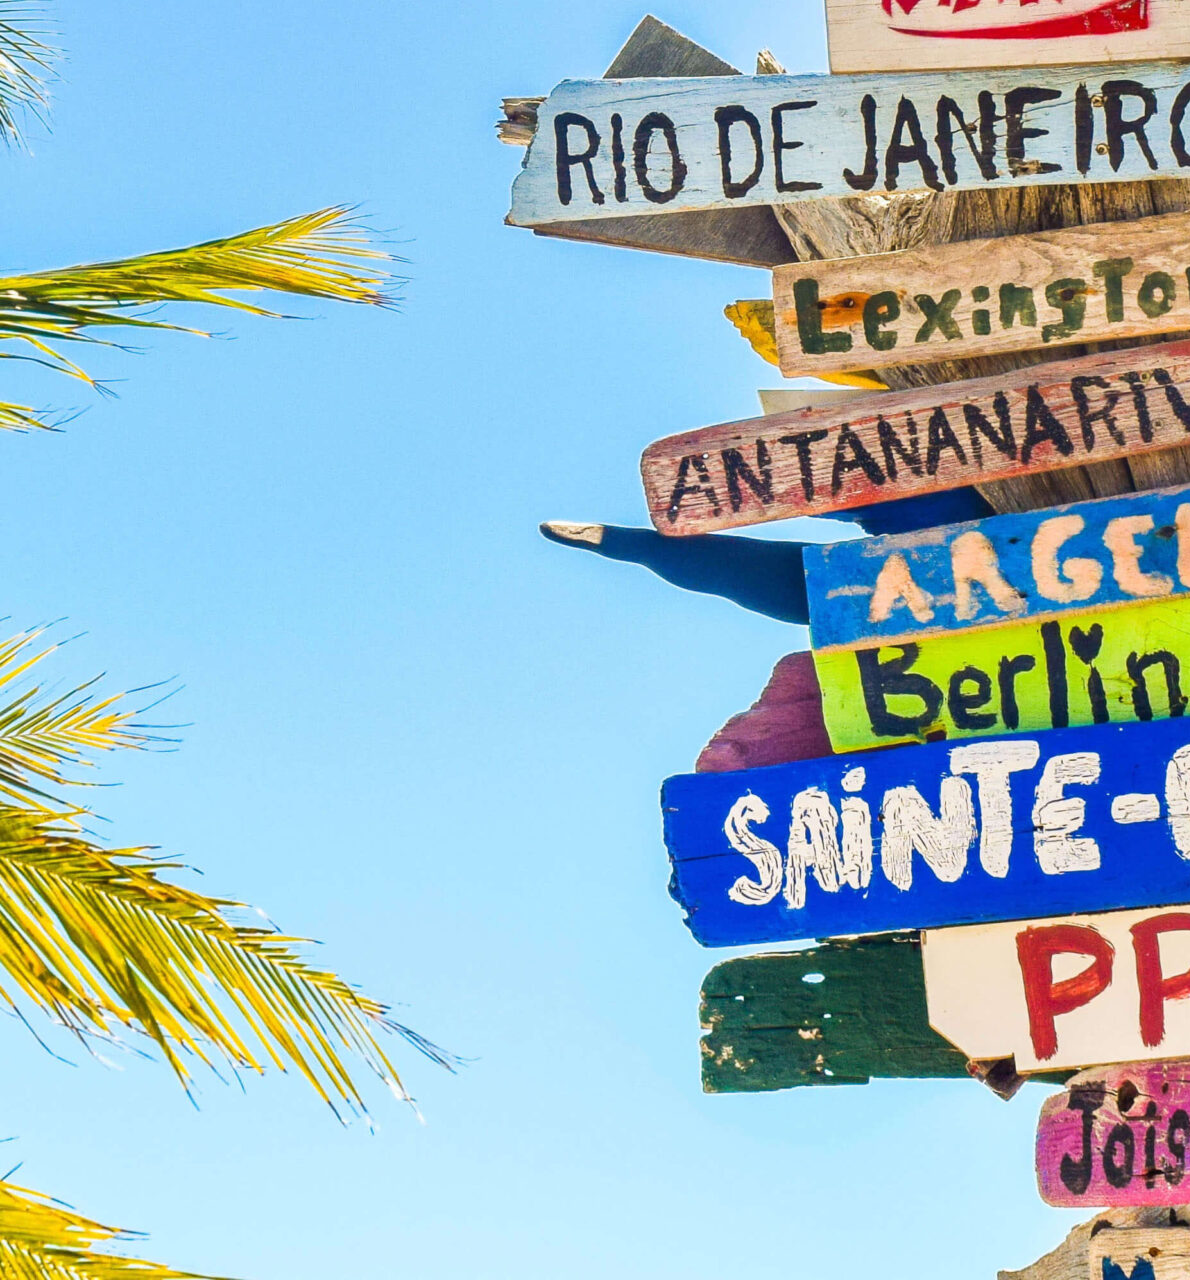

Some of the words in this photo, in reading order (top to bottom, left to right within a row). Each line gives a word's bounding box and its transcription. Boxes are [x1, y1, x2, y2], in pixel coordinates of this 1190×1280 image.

[553, 111, 689, 205] RIO
[714, 100, 825, 198] DE
[856, 620, 1190, 738] Berlin
